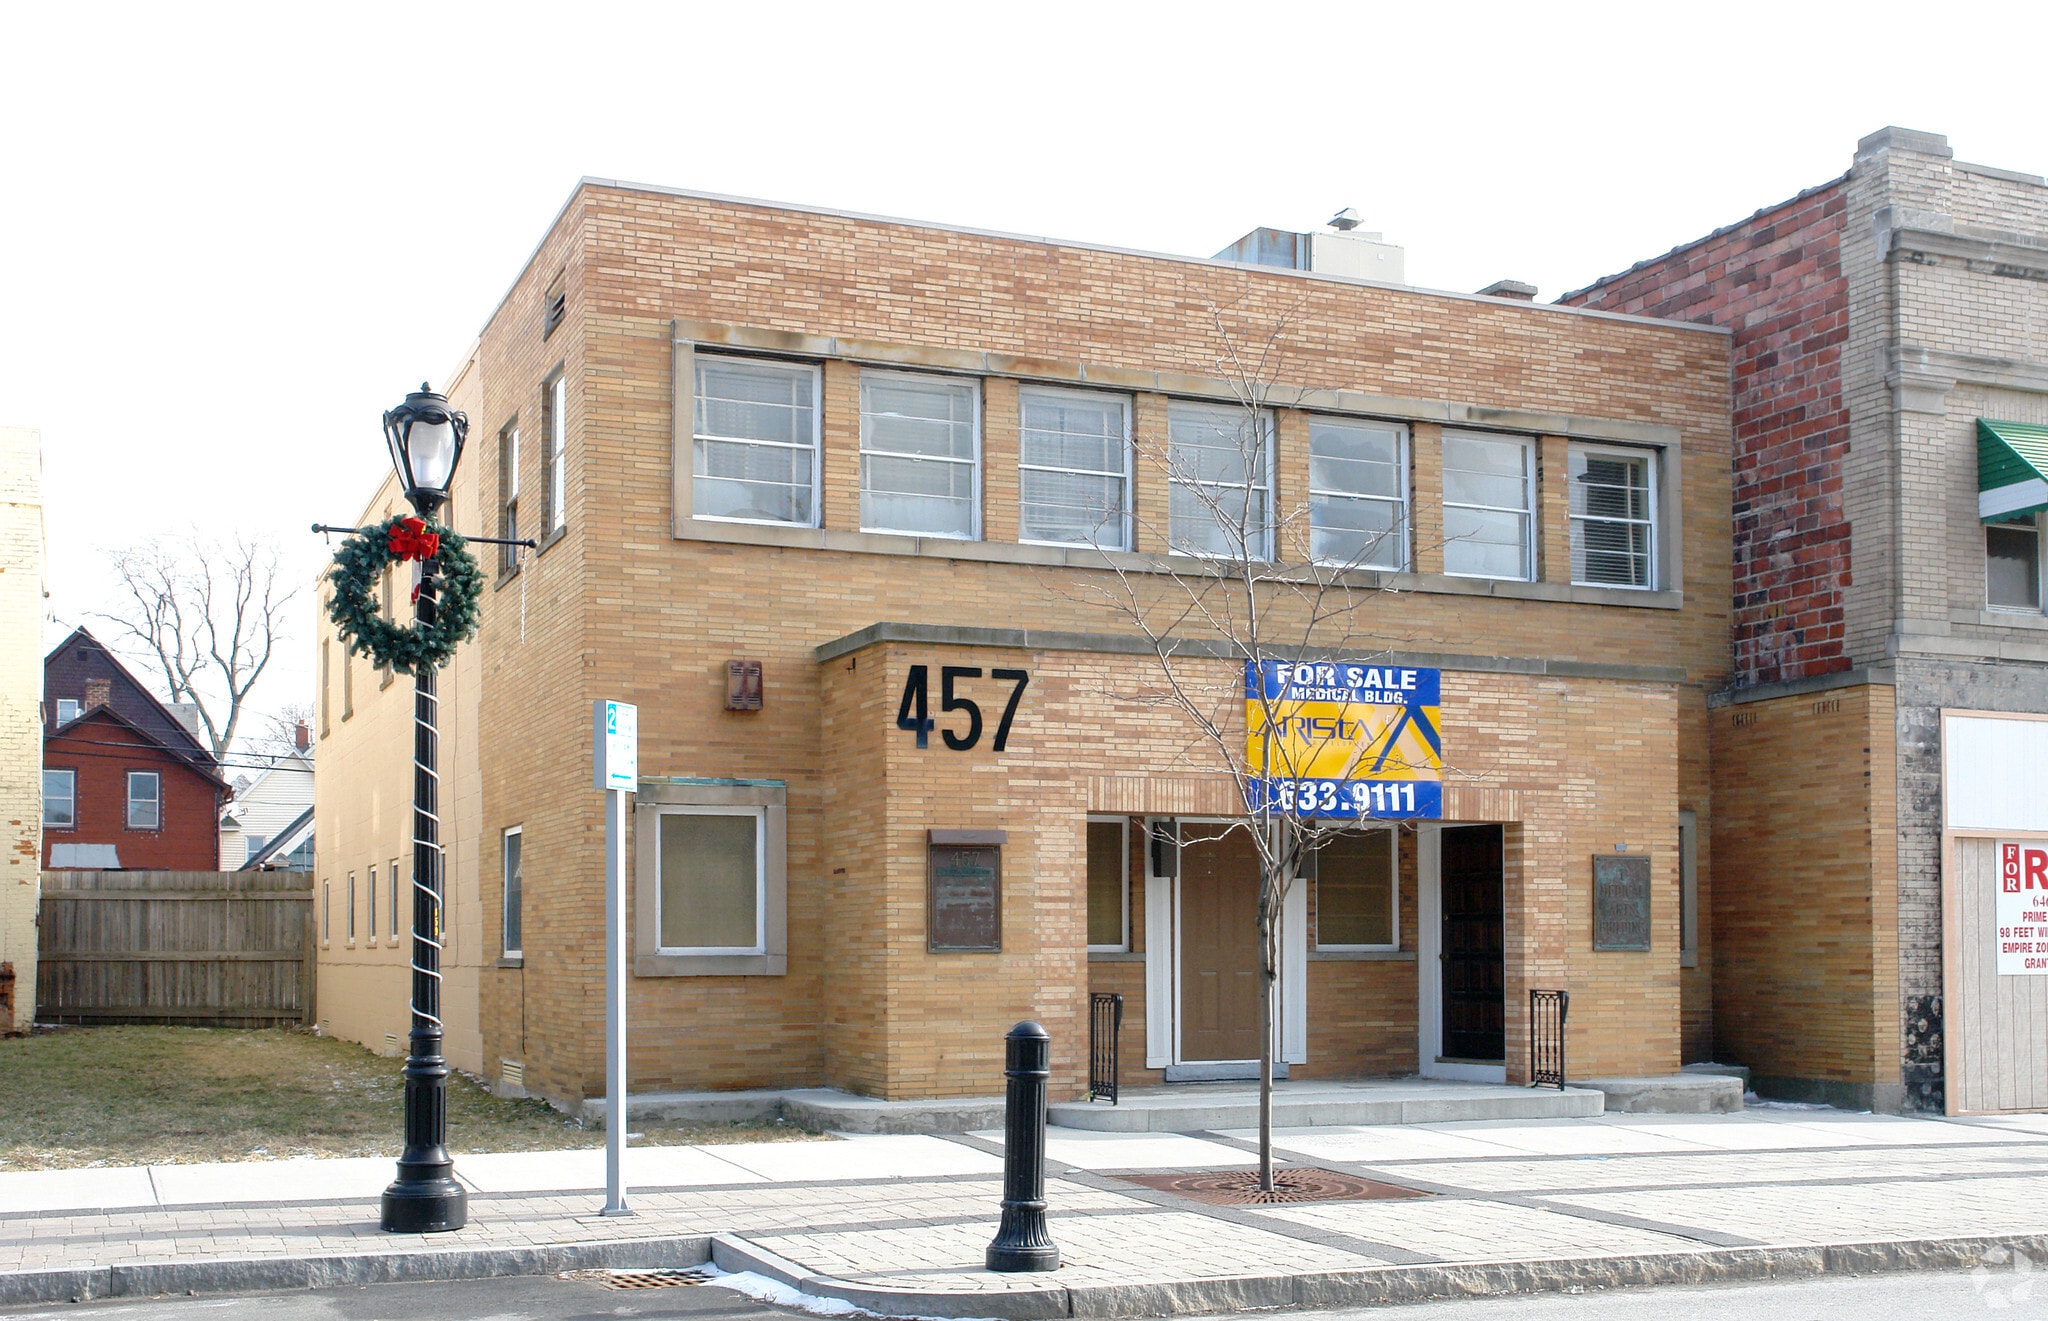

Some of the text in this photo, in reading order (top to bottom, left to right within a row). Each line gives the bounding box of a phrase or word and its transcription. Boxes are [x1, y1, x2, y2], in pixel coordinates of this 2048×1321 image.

[1276, 664, 1417, 690] FOR SALE
[1291, 686, 1408, 704] MEDICAL BLDG.
[608, 706, 616, 731] 2
[896, 664, 1029, 752] 457
[1280, 781, 1415, 811] 633.9111
[951, 851, 980, 866] 457
[2005, 846, 2018, 892] FOR
[2022, 911, 2047, 922] PRIME
[1999, 927, 2011, 938] 98
[2014, 927, 2034, 938] FEET
[2002, 942, 2033, 953] EMPIRE
